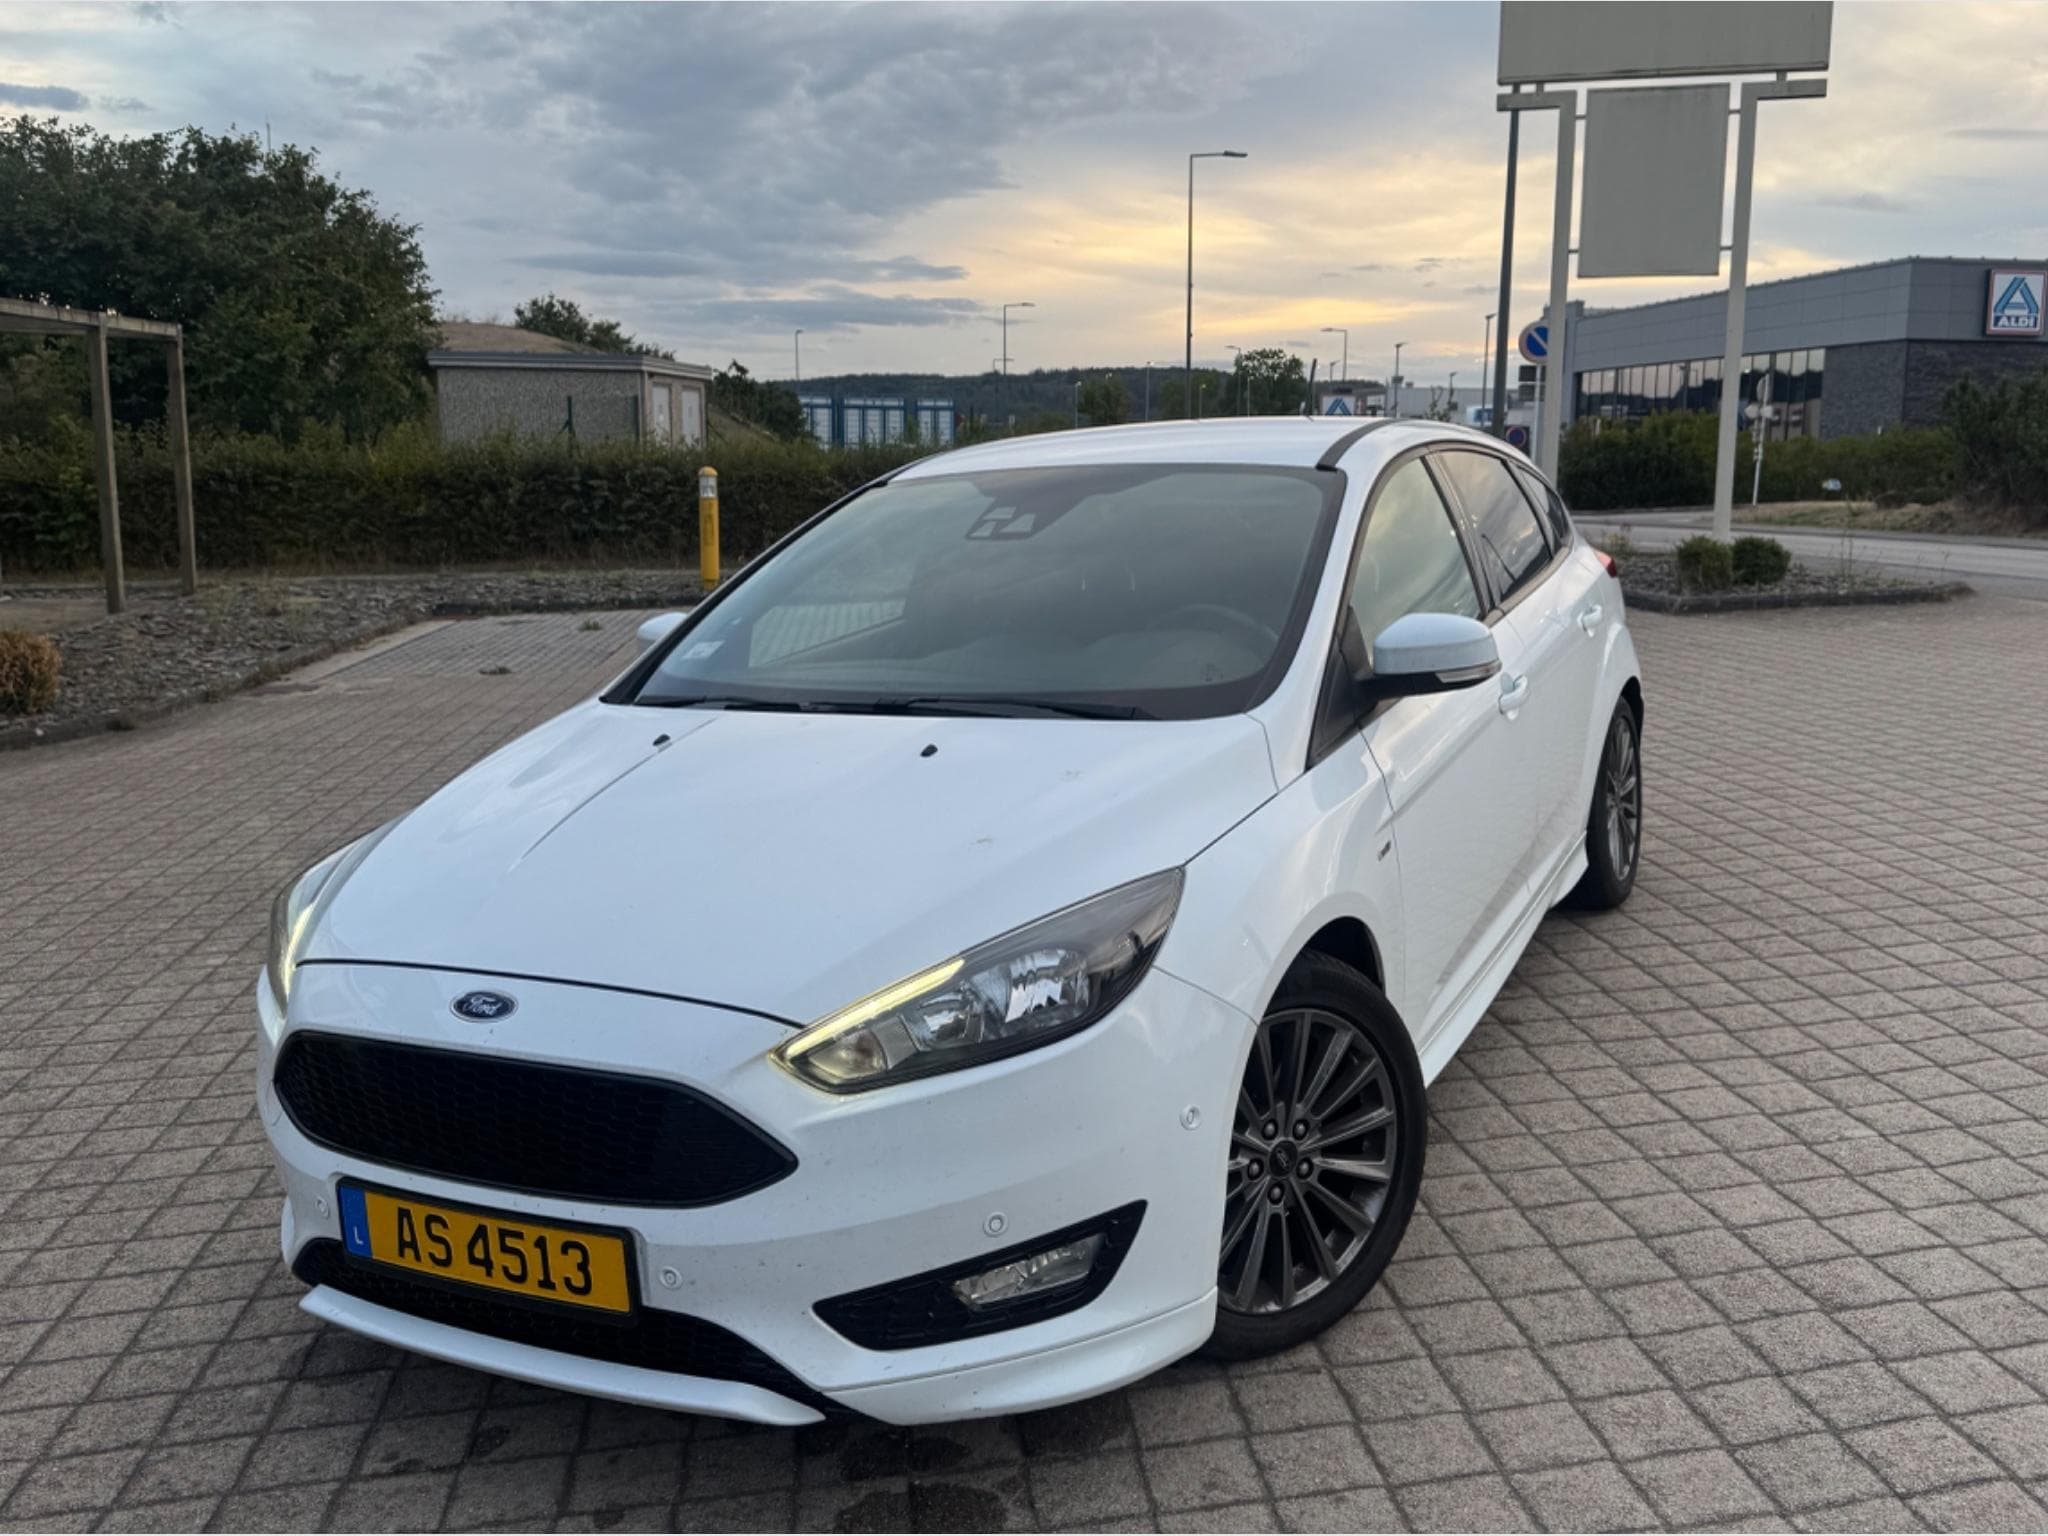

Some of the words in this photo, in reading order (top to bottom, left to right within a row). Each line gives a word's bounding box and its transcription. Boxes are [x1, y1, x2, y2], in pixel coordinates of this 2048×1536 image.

[1997, 315, 2035, 328] ALDI
[462, 994, 502, 1016] Ford
[352, 1226, 364, 1245] L
[396, 1206, 453, 1268] AS
[467, 1223, 593, 1297] 4513
